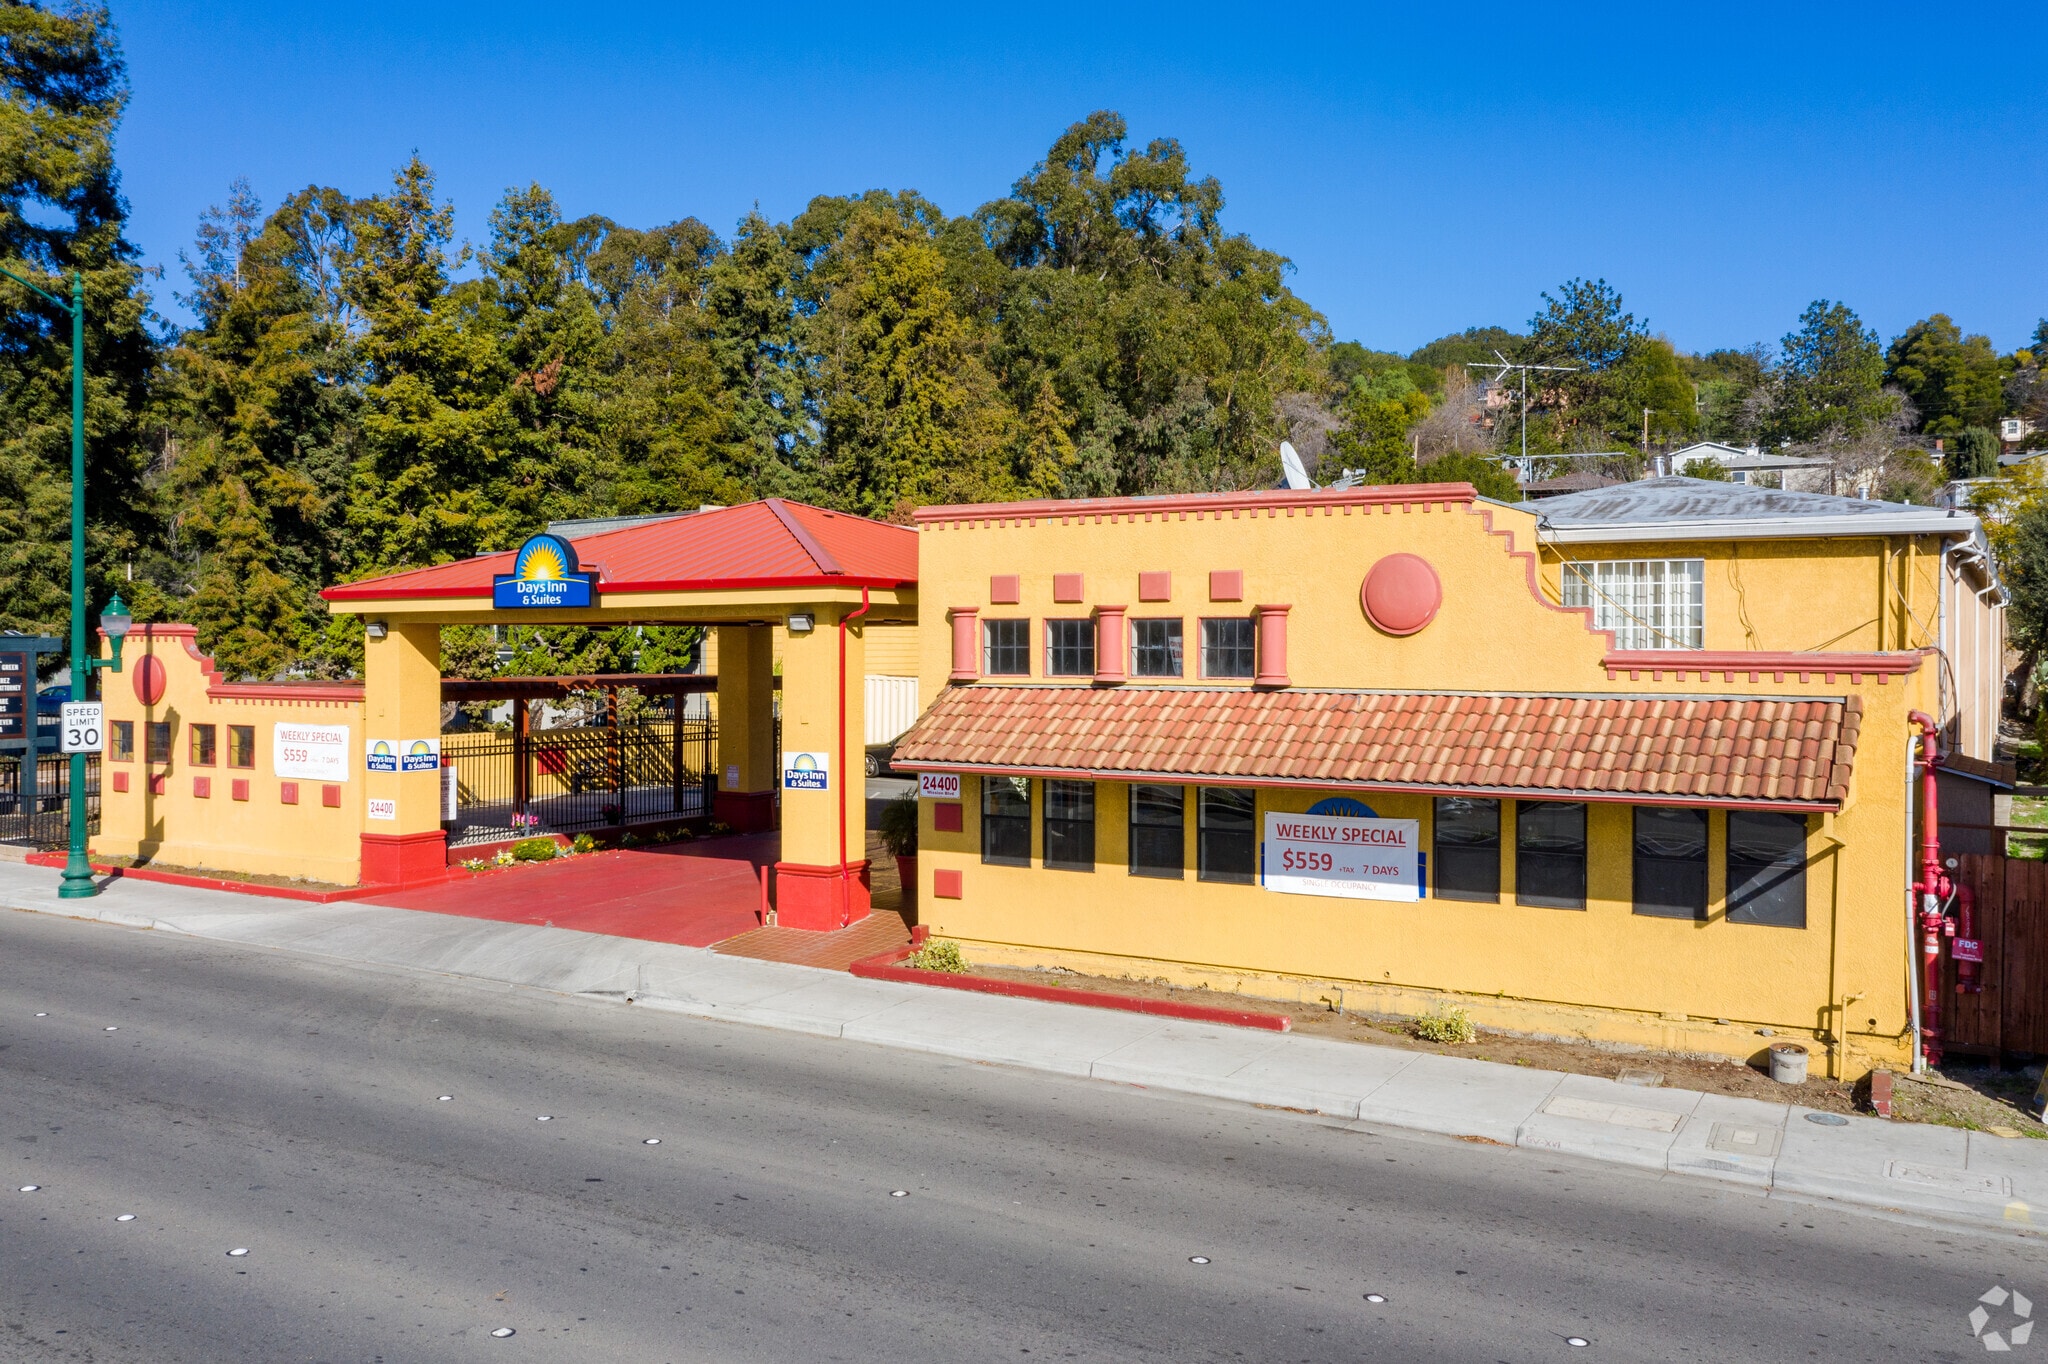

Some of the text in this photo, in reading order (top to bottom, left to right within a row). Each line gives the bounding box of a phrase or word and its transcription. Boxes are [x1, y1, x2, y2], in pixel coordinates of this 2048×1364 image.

[517, 581, 567, 595] Days Inn
[522, 594, 561, 605] & Suites
[66, 708, 100, 717] SPEED
[69, 718, 96, 726] LIMIT
[68, 728, 99, 746] 30
[280, 730, 343, 743] WEEKLY SPECIAL
[283, 747, 308, 762] $559
[368, 755, 383, 763] Days
[403, 754, 437, 763] Days Inn
[787, 770, 825, 780] Days Inn
[798, 779, 821, 787] Suites
[922, 775, 958, 791] 24400
[370, 802, 393, 814] 24400
[1276, 823, 1407, 844] WEEKLY SPECIAL
[1282, 848, 1333, 872] $559
[1363, 864, 1369, 874] 7
[1372, 865, 1399, 876] DAYS
[1302, 878, 1377, 891] SINGLE OCCUPANCY
[1958, 939, 1978, 950] FDC
